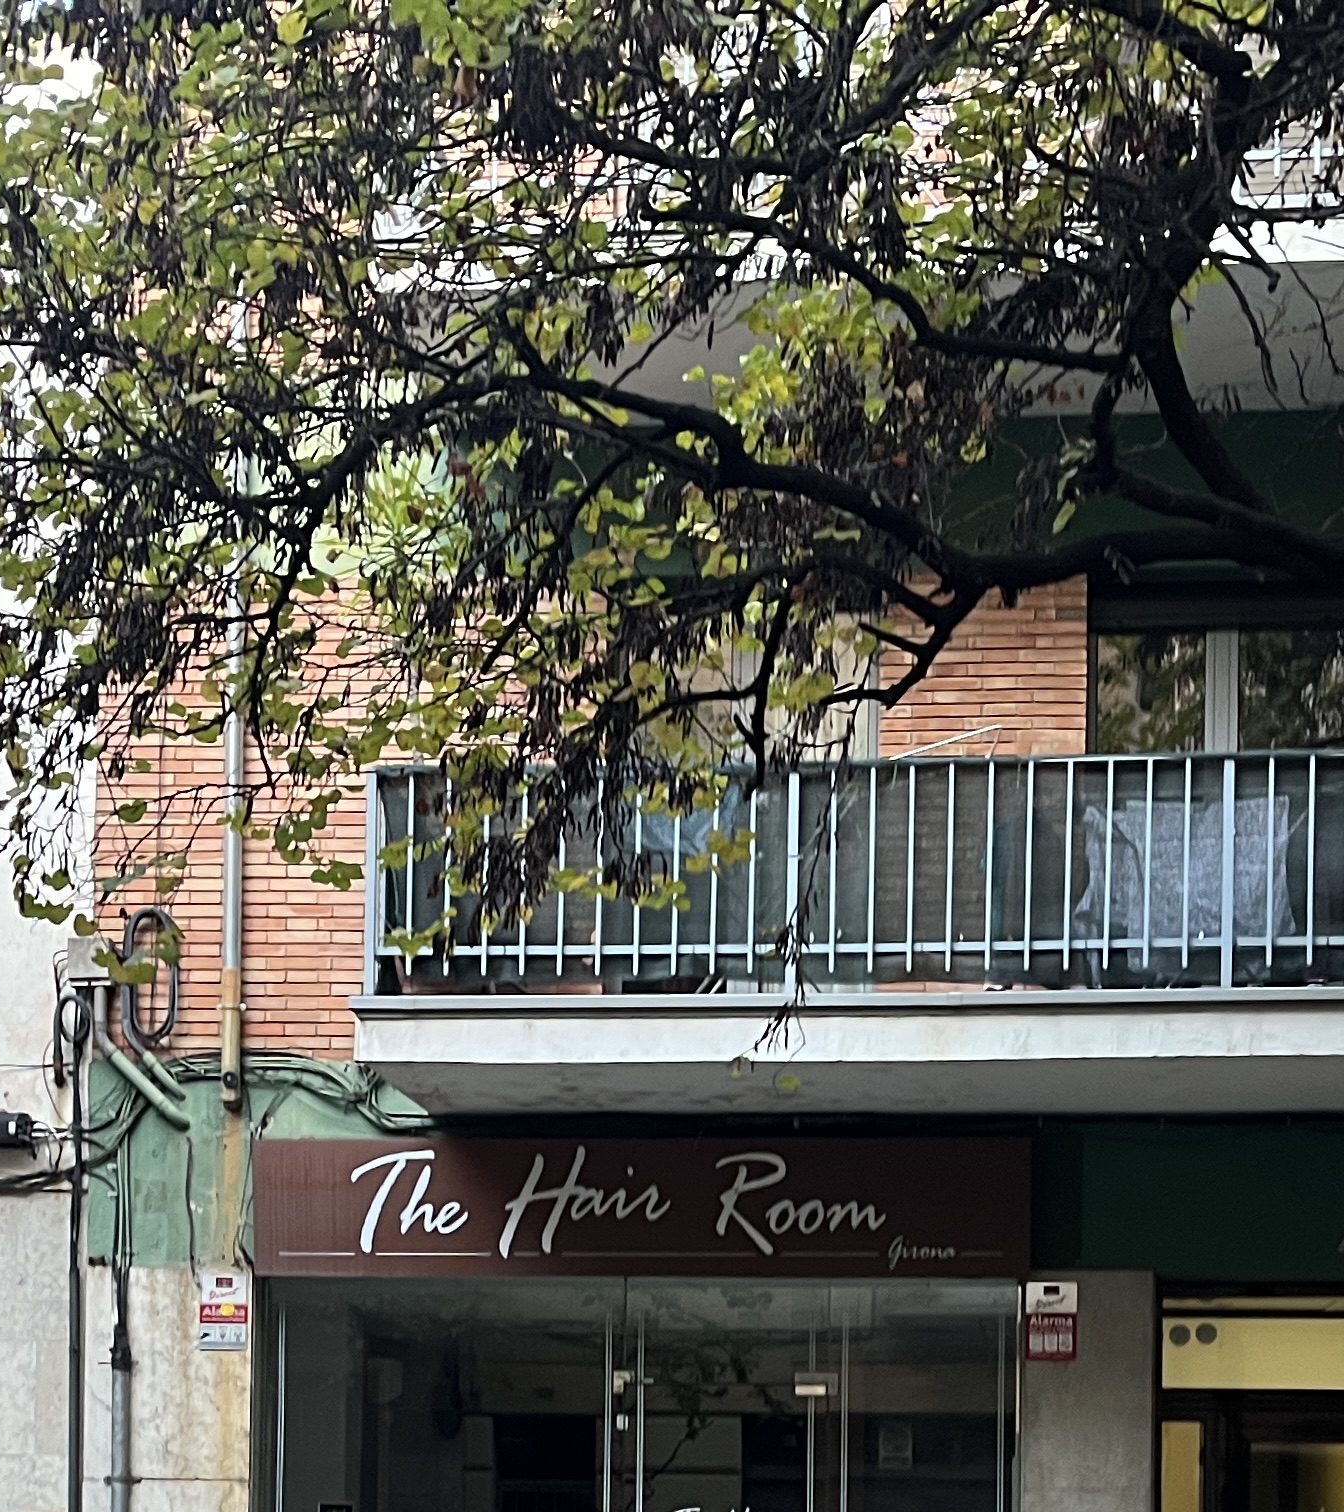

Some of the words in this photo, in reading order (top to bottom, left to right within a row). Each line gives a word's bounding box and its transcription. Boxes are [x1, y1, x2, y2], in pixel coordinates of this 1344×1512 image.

[351, 1149, 468, 1254] The
[498, 1145, 671, 1259] Hair
[715, 1151, 886, 1256] Room
[888, 1235, 957, 1272] Girona
[1030, 1314, 1073, 1327] Alarma
